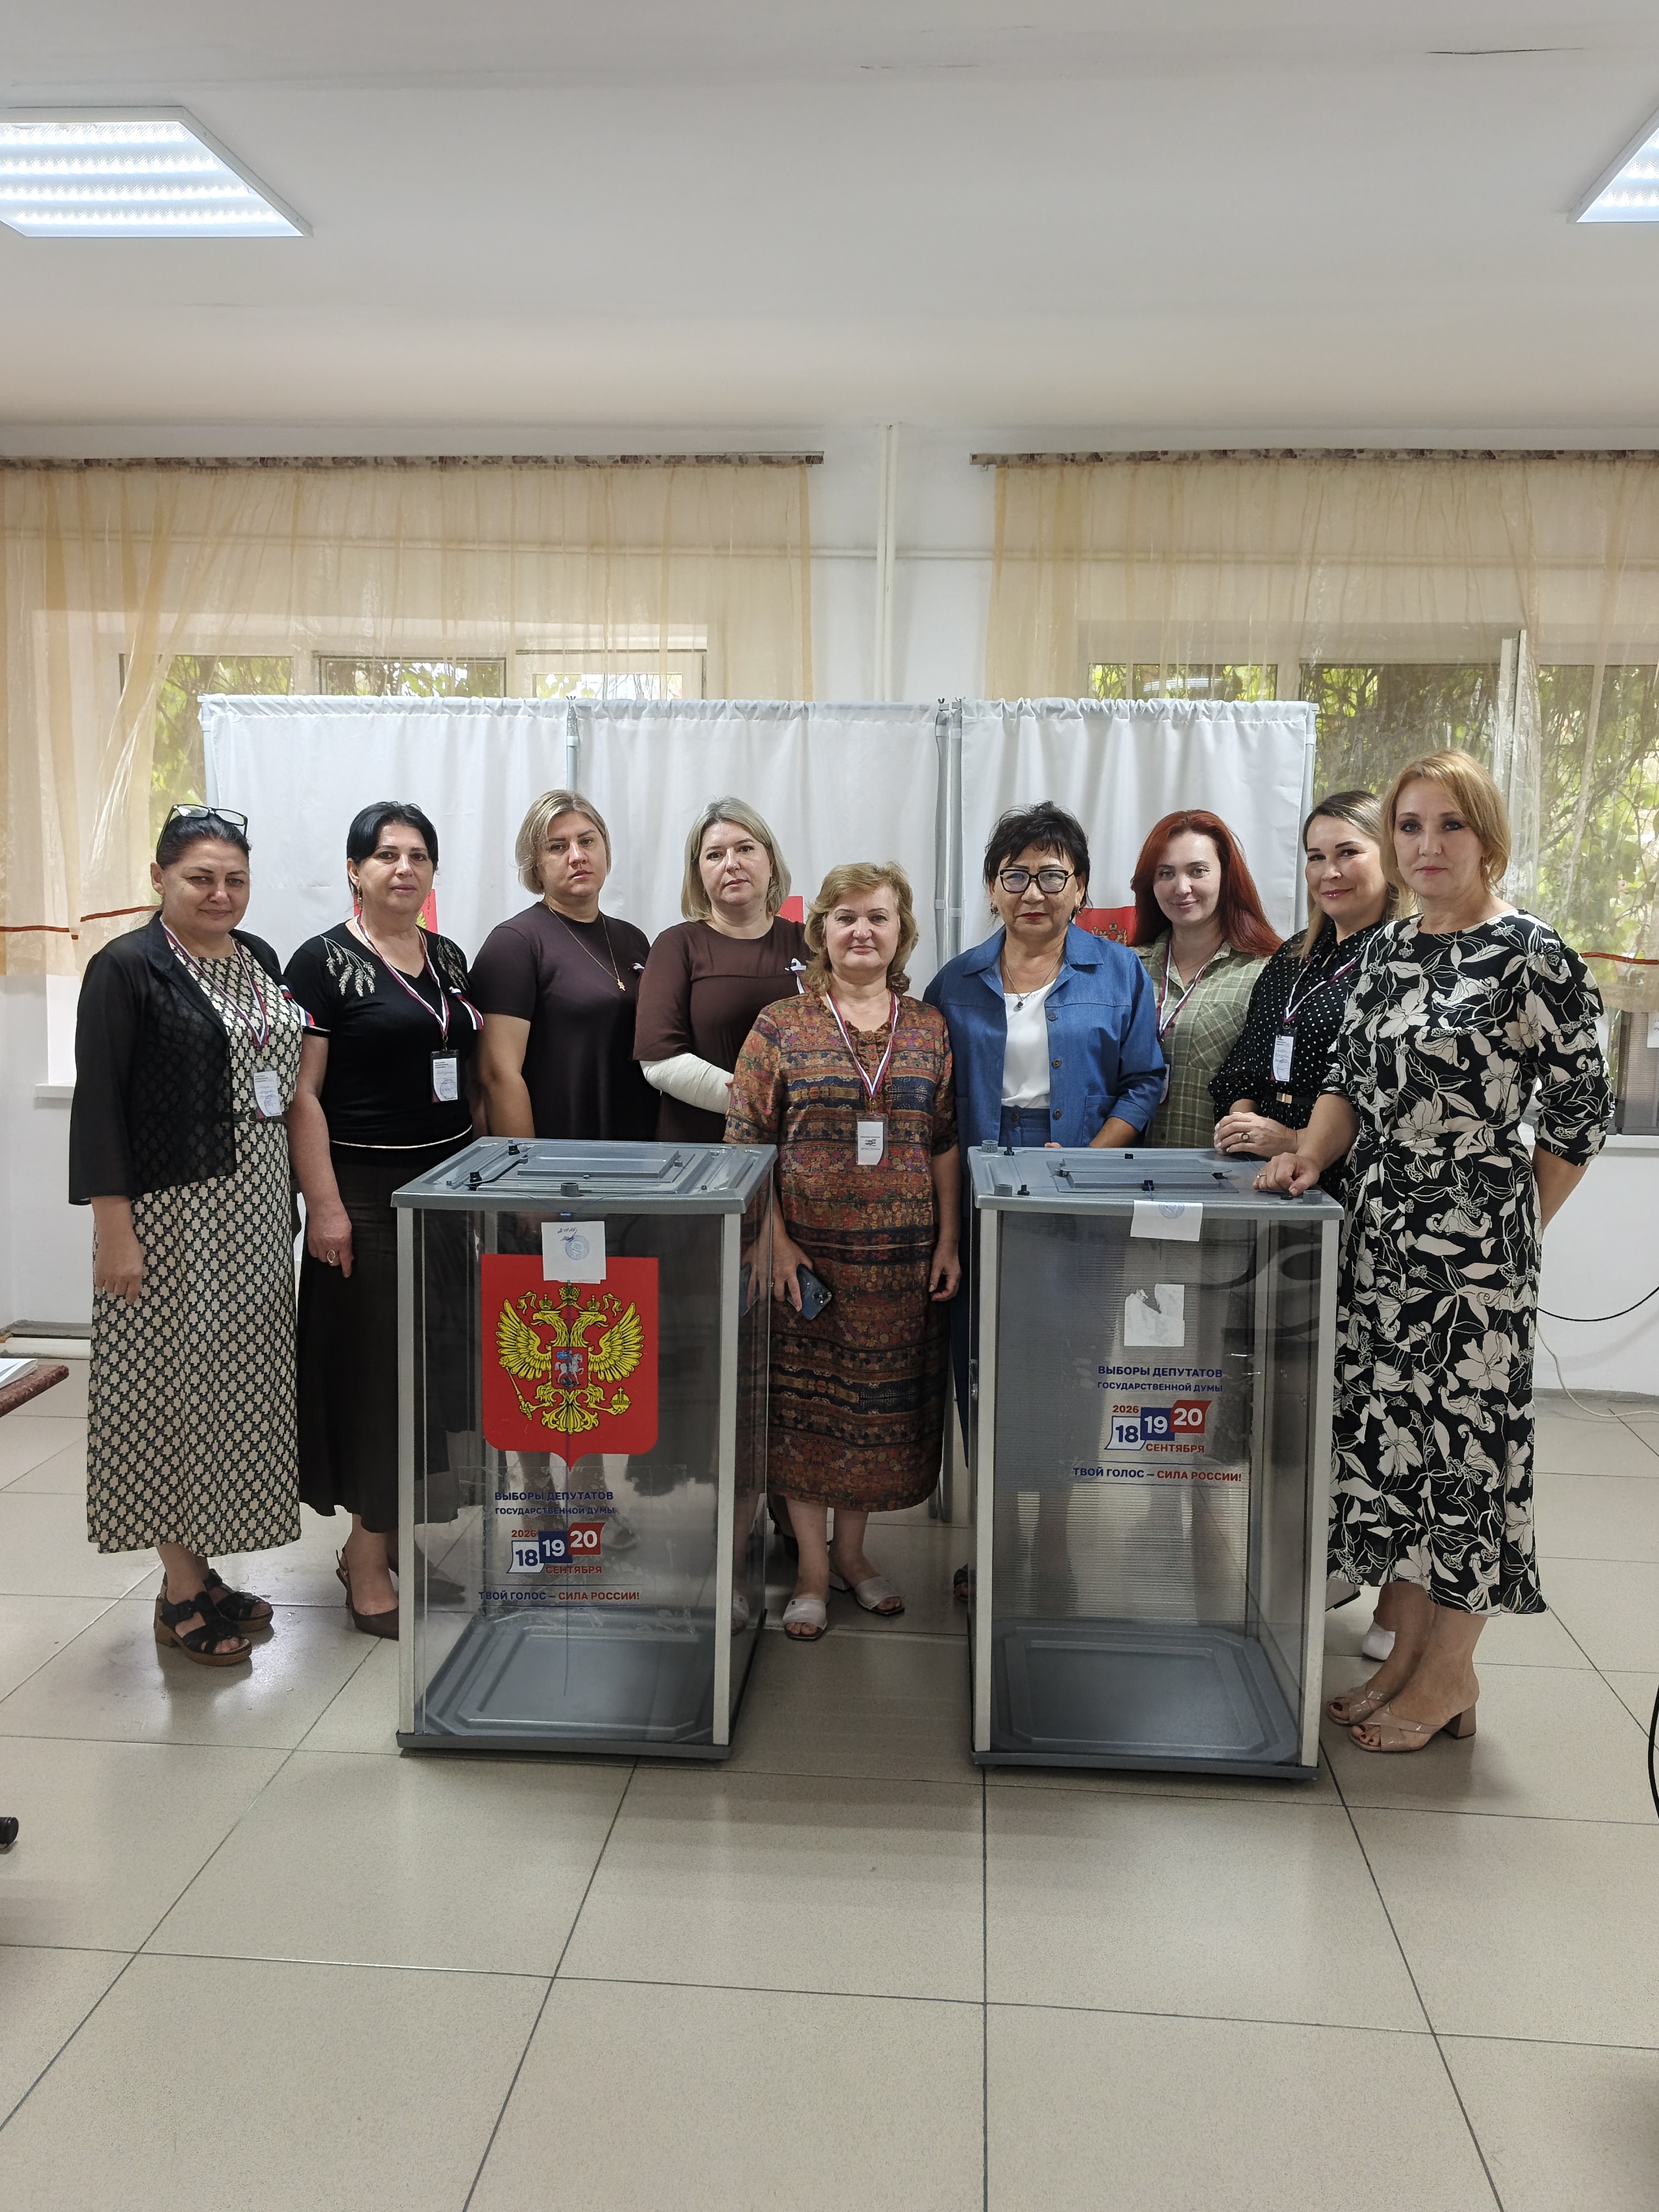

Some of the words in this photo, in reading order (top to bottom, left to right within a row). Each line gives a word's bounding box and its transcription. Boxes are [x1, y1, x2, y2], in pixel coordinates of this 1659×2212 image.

[1098, 1366, 1150, 1376] ВЫБОРЫ
[1152, 1367, 1223, 1378] ДЕПУТАТОВ
[1097, 1381, 1191, 1391] ГОСУДАРСТВЕННОЙ
[1193, 1384, 1223, 1392] ДУМЫ
[1112, 1405, 1139, 1414] 2026
[1115, 1425, 1139, 1443] 18
[1144, 1415, 1168, 1434] 19
[1173, 1408, 1203, 1426] 20
[1145, 1443, 1205, 1453] СЕНТЯБРЯ
[1073, 1466, 1104, 1477] ТВОЙ
[1106, 1468, 1144, 1478] ГОЛОС
[1157, 1470, 1188, 1480] СИЛА
[1191, 1472, 1242, 1482] РОССИИ!
[495, 1492, 544, 1501] ВЫБОРЫ
[546, 1491, 614, 1501] ДЕПУТАТОВ
[495, 1506, 585, 1515] ГОСУДАРСТВЕННОЙ
[511, 1529, 537, 1538] 2026
[515, 1549, 538, 1566] 18
[542, 1539, 566, 1557] 19
[570, 1530, 598, 1548] 20
[545, 1566, 603, 1574] СЕНТЯБРЯ
[478, 1590, 507, 1600] ТВОЙ
[510, 1592, 546, 1600] ГОЛОС
[558, 1592, 588, 1600] СИЛА
[591, 1592, 640, 1600] РОССИИ!
